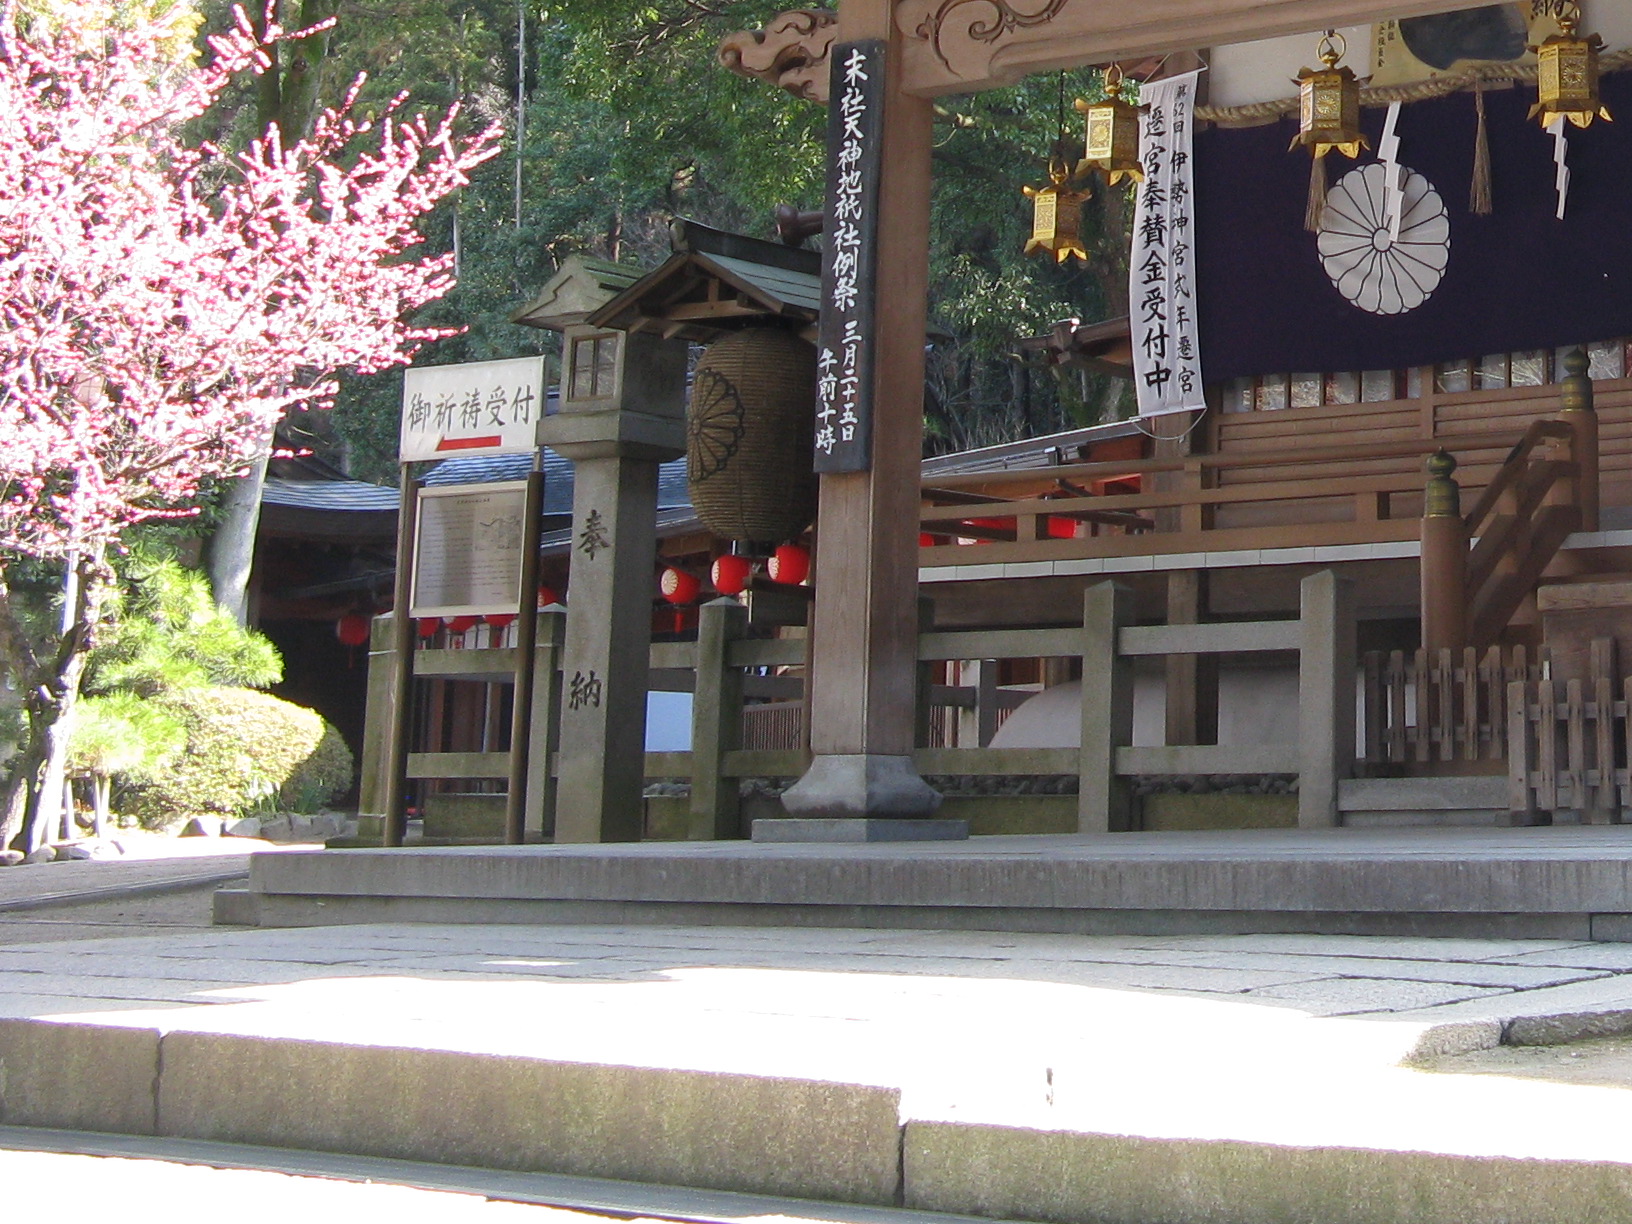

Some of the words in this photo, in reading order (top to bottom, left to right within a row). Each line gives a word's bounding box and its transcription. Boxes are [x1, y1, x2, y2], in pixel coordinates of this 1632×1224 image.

[1139, 106, 1171, 398] 遷宮奉賛金受付中
[407, 384, 535, 433] 御祈祷受付
[815, 347, 839, 455] 午前十時
[839, 320, 863, 443] 三月二十五日
[569, 509, 611, 711] 奉納
